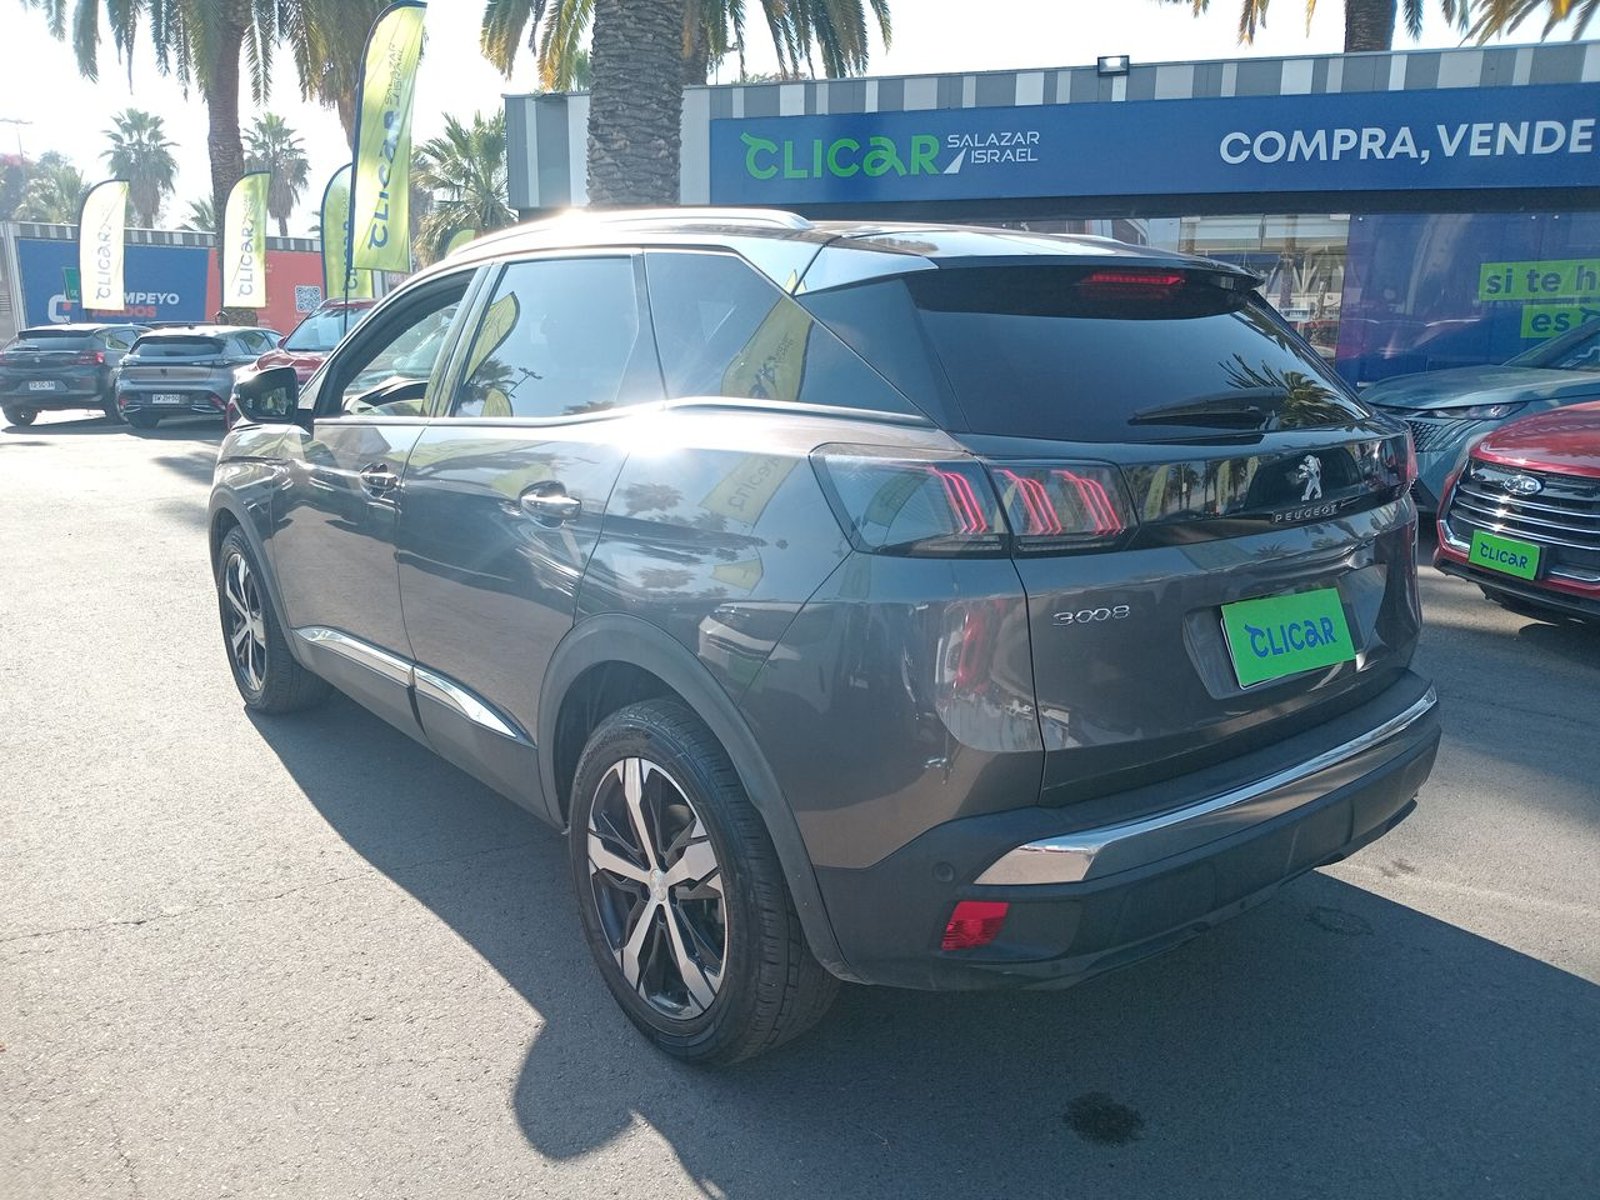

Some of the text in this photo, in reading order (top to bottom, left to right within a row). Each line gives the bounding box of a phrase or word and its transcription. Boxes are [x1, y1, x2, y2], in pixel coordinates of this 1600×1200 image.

[946, 131, 1040, 148] SALAZAR
[1219, 118, 1597, 165] COMPRA, VENDE
[970, 147, 1039, 164] ISRAEL
[1486, 268, 1513, 295] si
[1526, 268, 1562, 293] te
[1531, 312, 1570, 333] es
[1274, 503, 1338, 522] PEUGEOT
[1052, 604, 1131, 627] 3008
